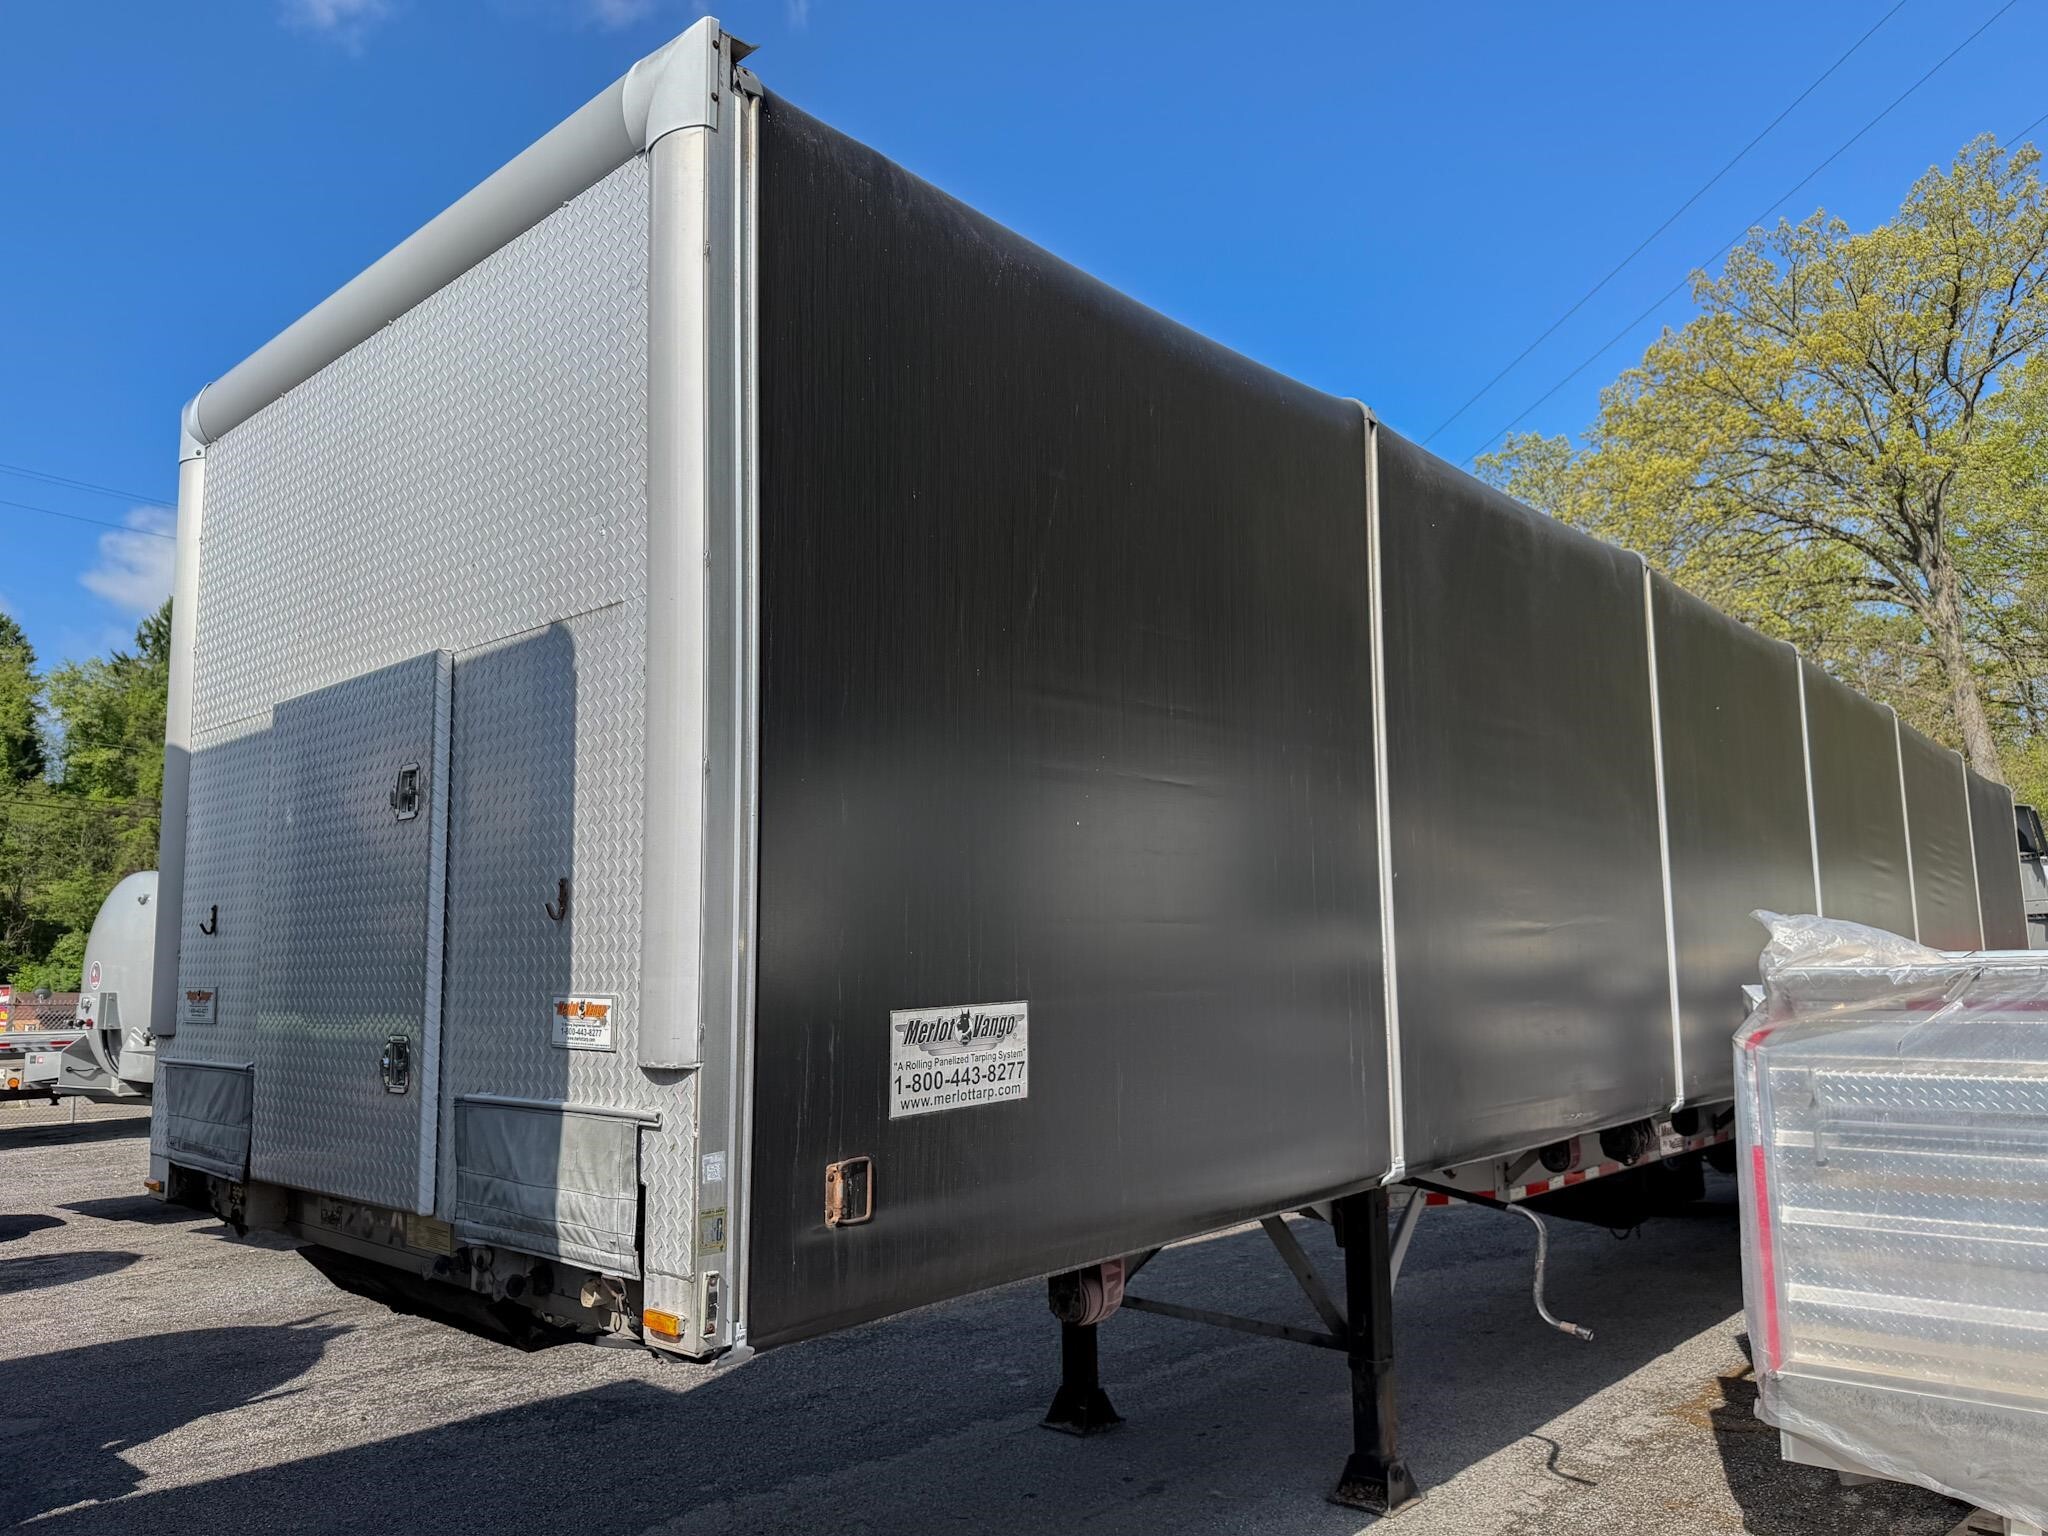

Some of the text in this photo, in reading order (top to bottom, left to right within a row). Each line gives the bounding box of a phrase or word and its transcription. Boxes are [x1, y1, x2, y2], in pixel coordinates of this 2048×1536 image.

[903, 1014, 1016, 1045] Merlot Vango
[905, 1060, 933, 1071] Rolling
[934, 1055, 969, 1067] Panelized
[970, 1052, 997, 1064] Tarping
[894, 1061, 1026, 1095] 1-800-443-8277
[900, 1084, 1021, 1110] www.merlottarp.com
